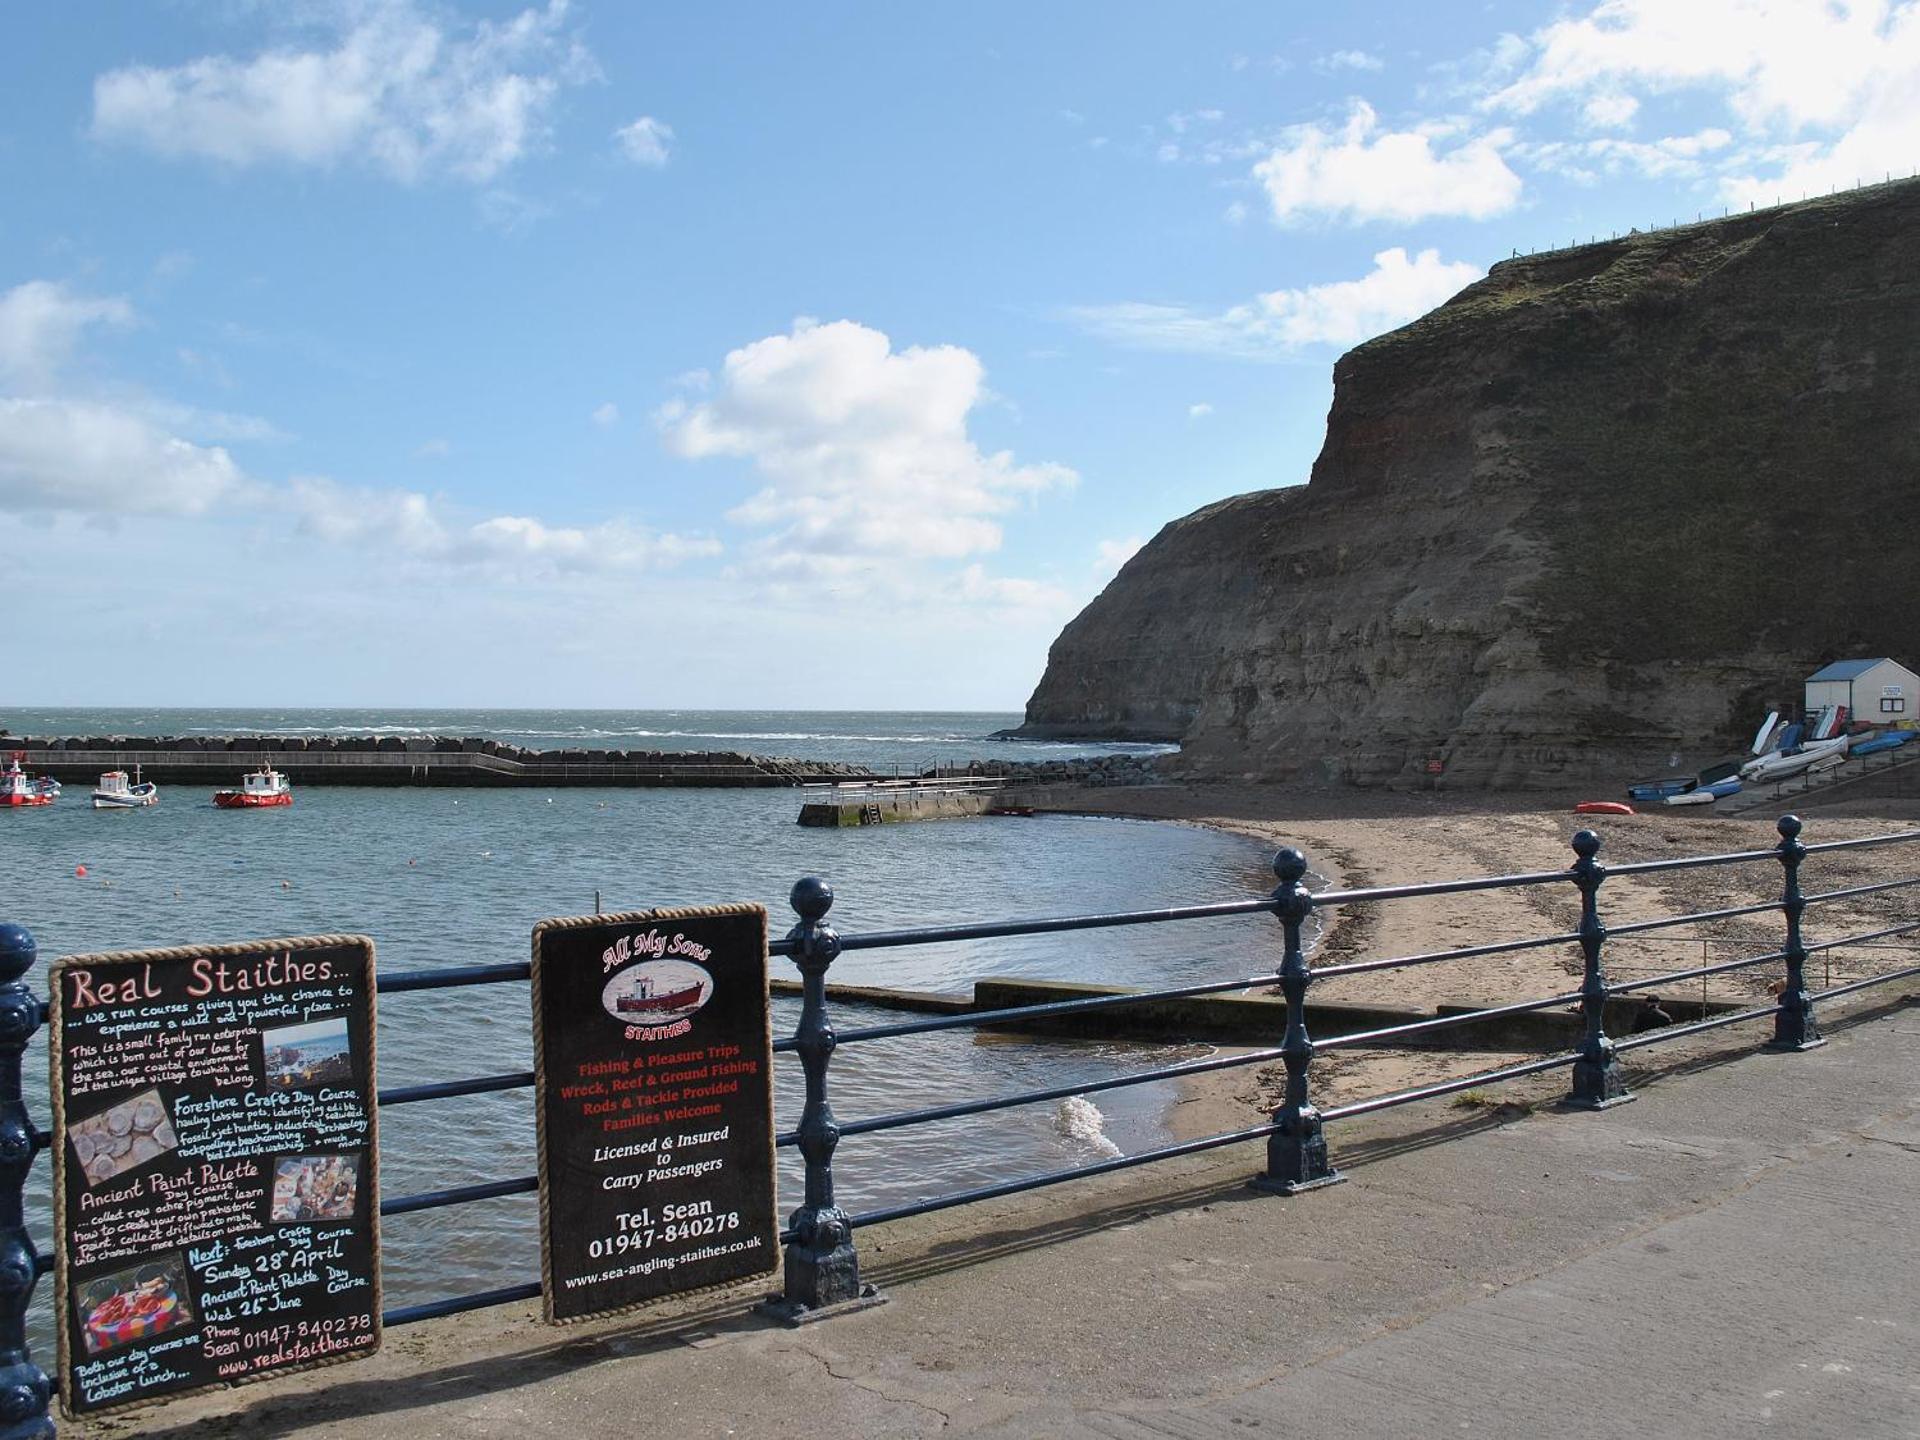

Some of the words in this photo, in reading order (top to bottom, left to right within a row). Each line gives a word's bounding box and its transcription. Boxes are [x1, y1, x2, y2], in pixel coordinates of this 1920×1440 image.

[602, 936, 631, 973] All
[633, 928, 667, 959] My
[668, 933, 712, 961] Sons
[67, 963, 161, 1008] Real
[111, 1008, 136, 1020] run
[140, 1003, 189, 1016] courses
[197, 1000, 233, 1017] giving
[238, 999, 258, 1015] you
[263, 993, 284, 1005] the
[292, 988, 333, 1001] chance
[337, 985, 353, 996] to
[99, 1021, 161, 1039] experience
[167, 1021, 177, 1029] a
[181, 1013, 210, 1027] wild
[216, 1012, 238, 1024] and
[247, 1006, 298, 1025] powerful
[624, 1018, 692, 1041] STAITHES
[69, 1045, 98, 1058] This
[103, 1042, 114, 1053] is
[116, 1042, 124, 1051] a
[125, 1034, 153, 1050] small
[157, 1030, 192, 1048] family
[194, 1032, 211, 1040] run
[73, 1056, 106, 1070] which
[109, 1055, 118, 1064] is
[122, 1052, 145, 1063] born
[149, 1047, 169, 1060] out
[174, 1046, 187, 1058] of
[189, 1047, 206, 1057] our
[211, 1042, 231, 1055] love
[235, 1040, 250, 1055] for
[578, 1057, 630, 1077] Fishing
[633, 1056, 644, 1069] &
[648, 1049, 704, 1067] Pleasure
[706, 1043, 740, 1060] Trips
[71, 1084, 89, 1096] and
[92, 1080, 109, 1090] the
[111, 1075, 147, 1088] unique
[149, 1071, 188, 1084] village
[190, 1067, 201, 1078] to
[201, 1064, 230, 1076] which
[235, 1063, 250, 1073] we
[72, 1072, 92, 1084] the
[121, 1066, 139, 1076] our
[144, 1061, 183, 1073] coastal
[215, 1075, 258, 1088] belong.
[561, 1080, 609, 1099] Wreck,
[612, 1073, 644, 1092] Reef
[646, 1072, 657, 1086] &
[660, 1066, 708, 1084] Ground
[711, 1059, 758, 1076] Fishing
[174, 1094, 239, 1116] Foreshore
[244, 1091, 290, 1108] Crafts
[291, 1091, 315, 1107] Day
[583, 1099, 617, 1116] Rods
[621, 1097, 633, 1109] &
[636, 1089, 680, 1107] Tackle
[682, 1080, 738, 1099] Provided
[176, 1115, 211, 1130] hauling
[211, 1111, 244, 1122] lobster
[273, 1105, 324, 1119] identifying
[327, 1102, 357, 1112] edible
[180, 1130, 211, 1146] fossil
[217, 1124, 233, 1140] jet
[274, 1119, 326, 1131] industrial
[603, 1113, 660, 1131] Families
[664, 1102, 721, 1120] Welcome
[206, 1150, 224, 1161] bird
[323, 1134, 347, 1144] much
[593, 1138, 657, 1162] Licensed
[661, 1136, 673, 1150] &
[677, 1126, 729, 1148] Insured
[602, 1173, 643, 1190] Carry
[647, 1157, 723, 1183] Passengers
[656, 1152, 671, 1166] to
[81, 1178, 144, 1211] Ancient
[148, 1167, 195, 1193] Paint
[201, 1160, 259, 1186] Palette
[164, 1191, 189, 1202] Day
[73, 1231, 99, 1242] how
[99, 1225, 115, 1236] to
[117, 1218, 150, 1232] create
[150, 1215, 176, 1233] your
[177, 1212, 199, 1221] own
[199, 1201, 257, 1221] prehistoric
[91, 1208, 125, 1225] collect
[127, 1207, 150, 1219] raw
[155, 1200, 184, 1214] ochre
[235, 1188, 264, 1200] learn
[616, 1208, 655, 1231] Tel.
[662, 1199, 713, 1223] Sean
[75, 1253, 96, 1266] into
[151, 1240, 174, 1251] more
[176, 1229, 211, 1245] details
[211, 1229, 224, 1237] on
[226, 1220, 264, 1234] website
[120, 1230, 163, 1245] collect
[165, 1220, 215, 1237] driftwood
[215, 1216, 225, 1225] to
[226, 1212, 252, 1222] make
[278, 1226, 312, 1241] Crafts
[288, 1237, 312, 1249] Day
[316, 1227, 354, 1241] Course
[588, 1211, 740, 1258] 01947-840278
[205, 1263, 252, 1284] Sunday
[290, 1239, 344, 1269] April
[565, 1236, 762, 1289] www.sea-angling-staithes.co.uk
[201, 1285, 248, 1308] Ancient
[247, 1277, 280, 1296] Paint
[278, 1270, 320, 1289] Palette
[325, 1266, 349, 1281] Day
[205, 1308, 237, 1322] Wed
[268, 1293, 303, 1311] June
[202, 1325, 241, 1339] Phone
[75, 1361, 106, 1378] Both
[107, 1355, 127, 1367] our
[128, 1349, 149, 1365] day
[149, 1338, 184, 1355] courses
[184, 1334, 200, 1344] are
[203, 1340, 239, 1358] Sean
[219, 1333, 375, 1376] www.realstaithes.com
[81, 1367, 130, 1390] inclusive
[132, 1362, 147, 1375] of
[148, 1362, 159, 1371] a
